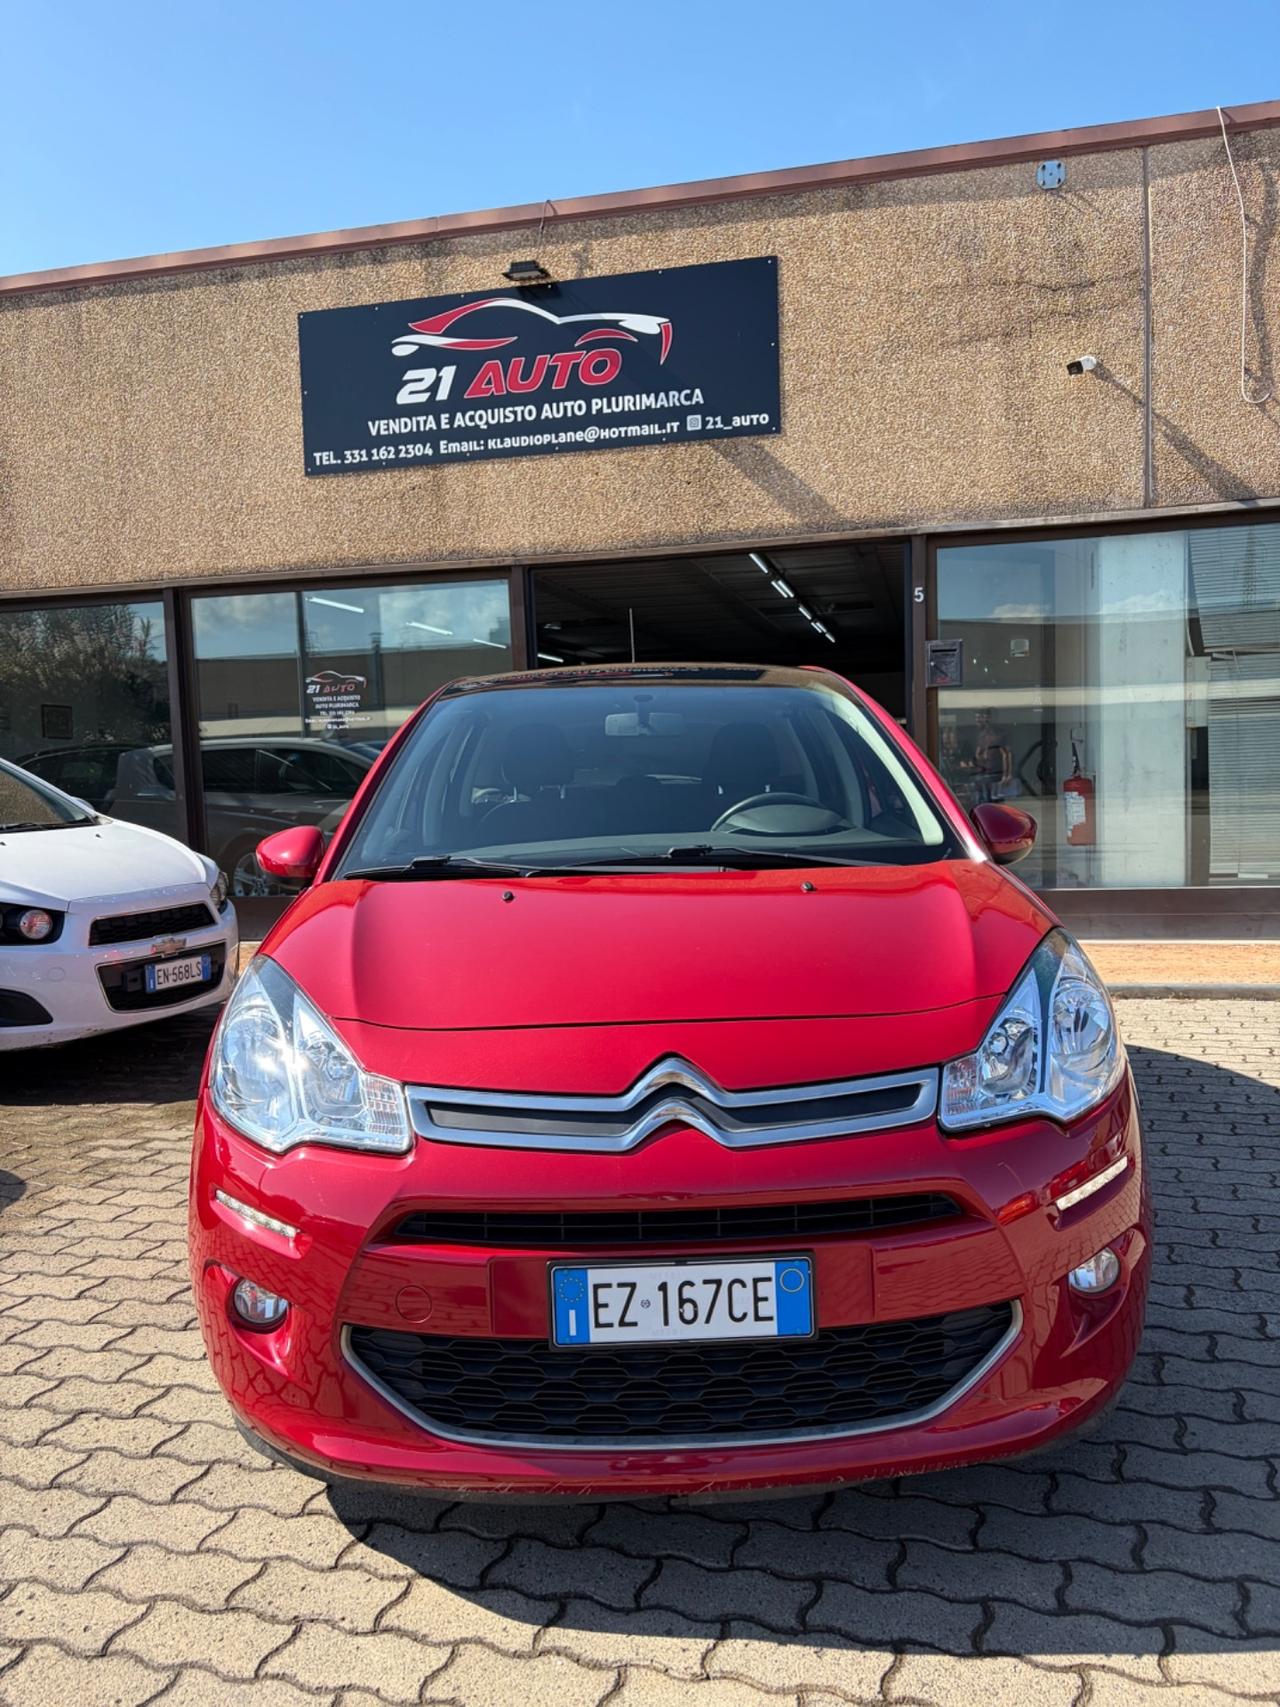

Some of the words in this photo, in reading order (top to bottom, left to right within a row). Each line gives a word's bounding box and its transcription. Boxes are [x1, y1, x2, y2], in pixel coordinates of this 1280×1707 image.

[396, 365, 457, 405] 21
[464, 348, 622, 399] AUTO
[368, 414, 437, 436] VENDITA
[440, 413, 450, 429] E
[453, 405, 536, 429] ACQUISTO
[540, 400, 587, 420] AUTO
[591, 388, 704, 415] PLURIMARCA
[313, 450, 341, 466] TEL.
[344, 448, 369, 464] 331
[371, 446, 396, 461] 162
[398, 443, 433, 458] 2304
[914, 587, 924, 602] 5
[306, 684, 320, 694] 21
[323, 683, 356, 693] AUTO
[657, 1276, 774, 1327] 167CE
